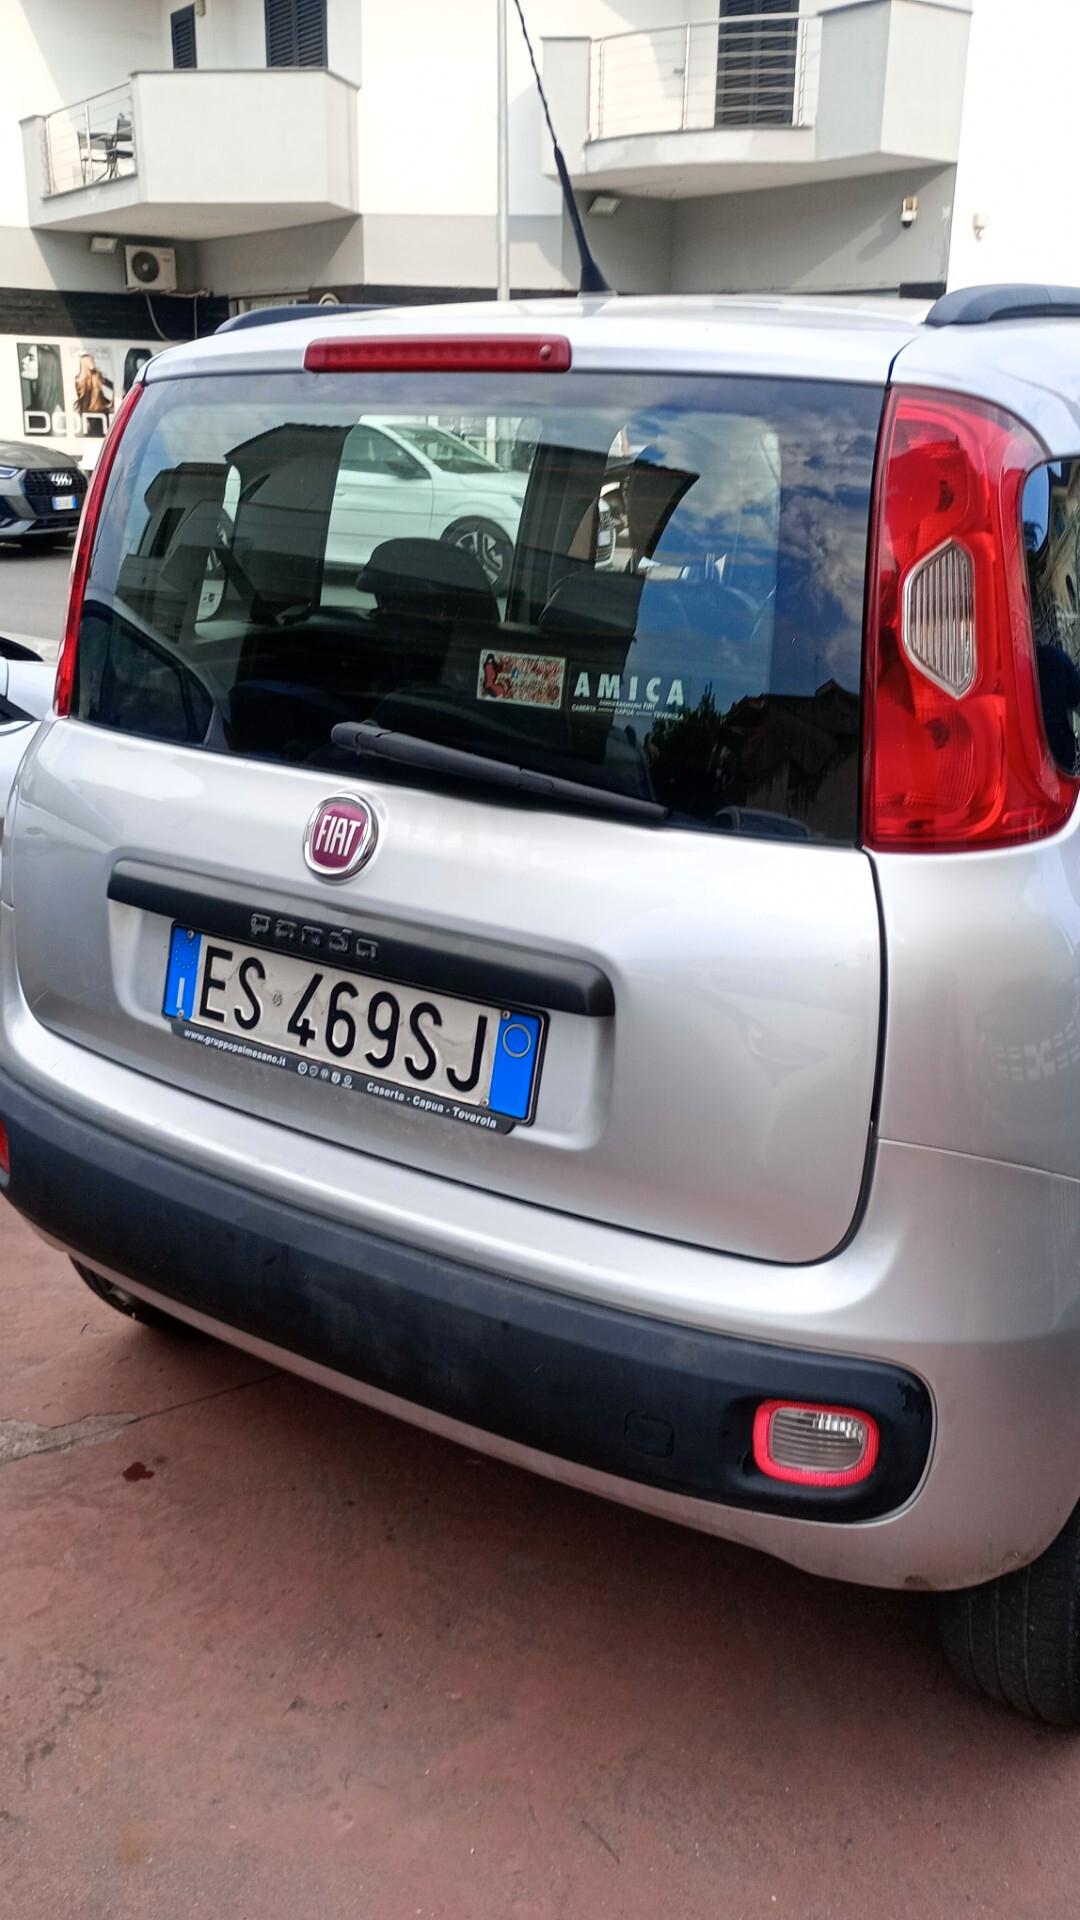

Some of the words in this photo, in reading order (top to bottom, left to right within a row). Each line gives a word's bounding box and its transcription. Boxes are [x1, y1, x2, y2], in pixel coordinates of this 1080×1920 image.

[573, 671, 684, 706] AMICA
[314, 814, 362, 857] FIAT
[199, 944, 266, 1031] ES
[287, 973, 488, 1092] 469SJ
[183, 1028, 287, 1067] www.gruppopalmesano.it
[366, 1081, 405, 1103] Caserta
[412, 1095, 444, 1114] Capua
[452, 1106, 497, 1129] Teverola
